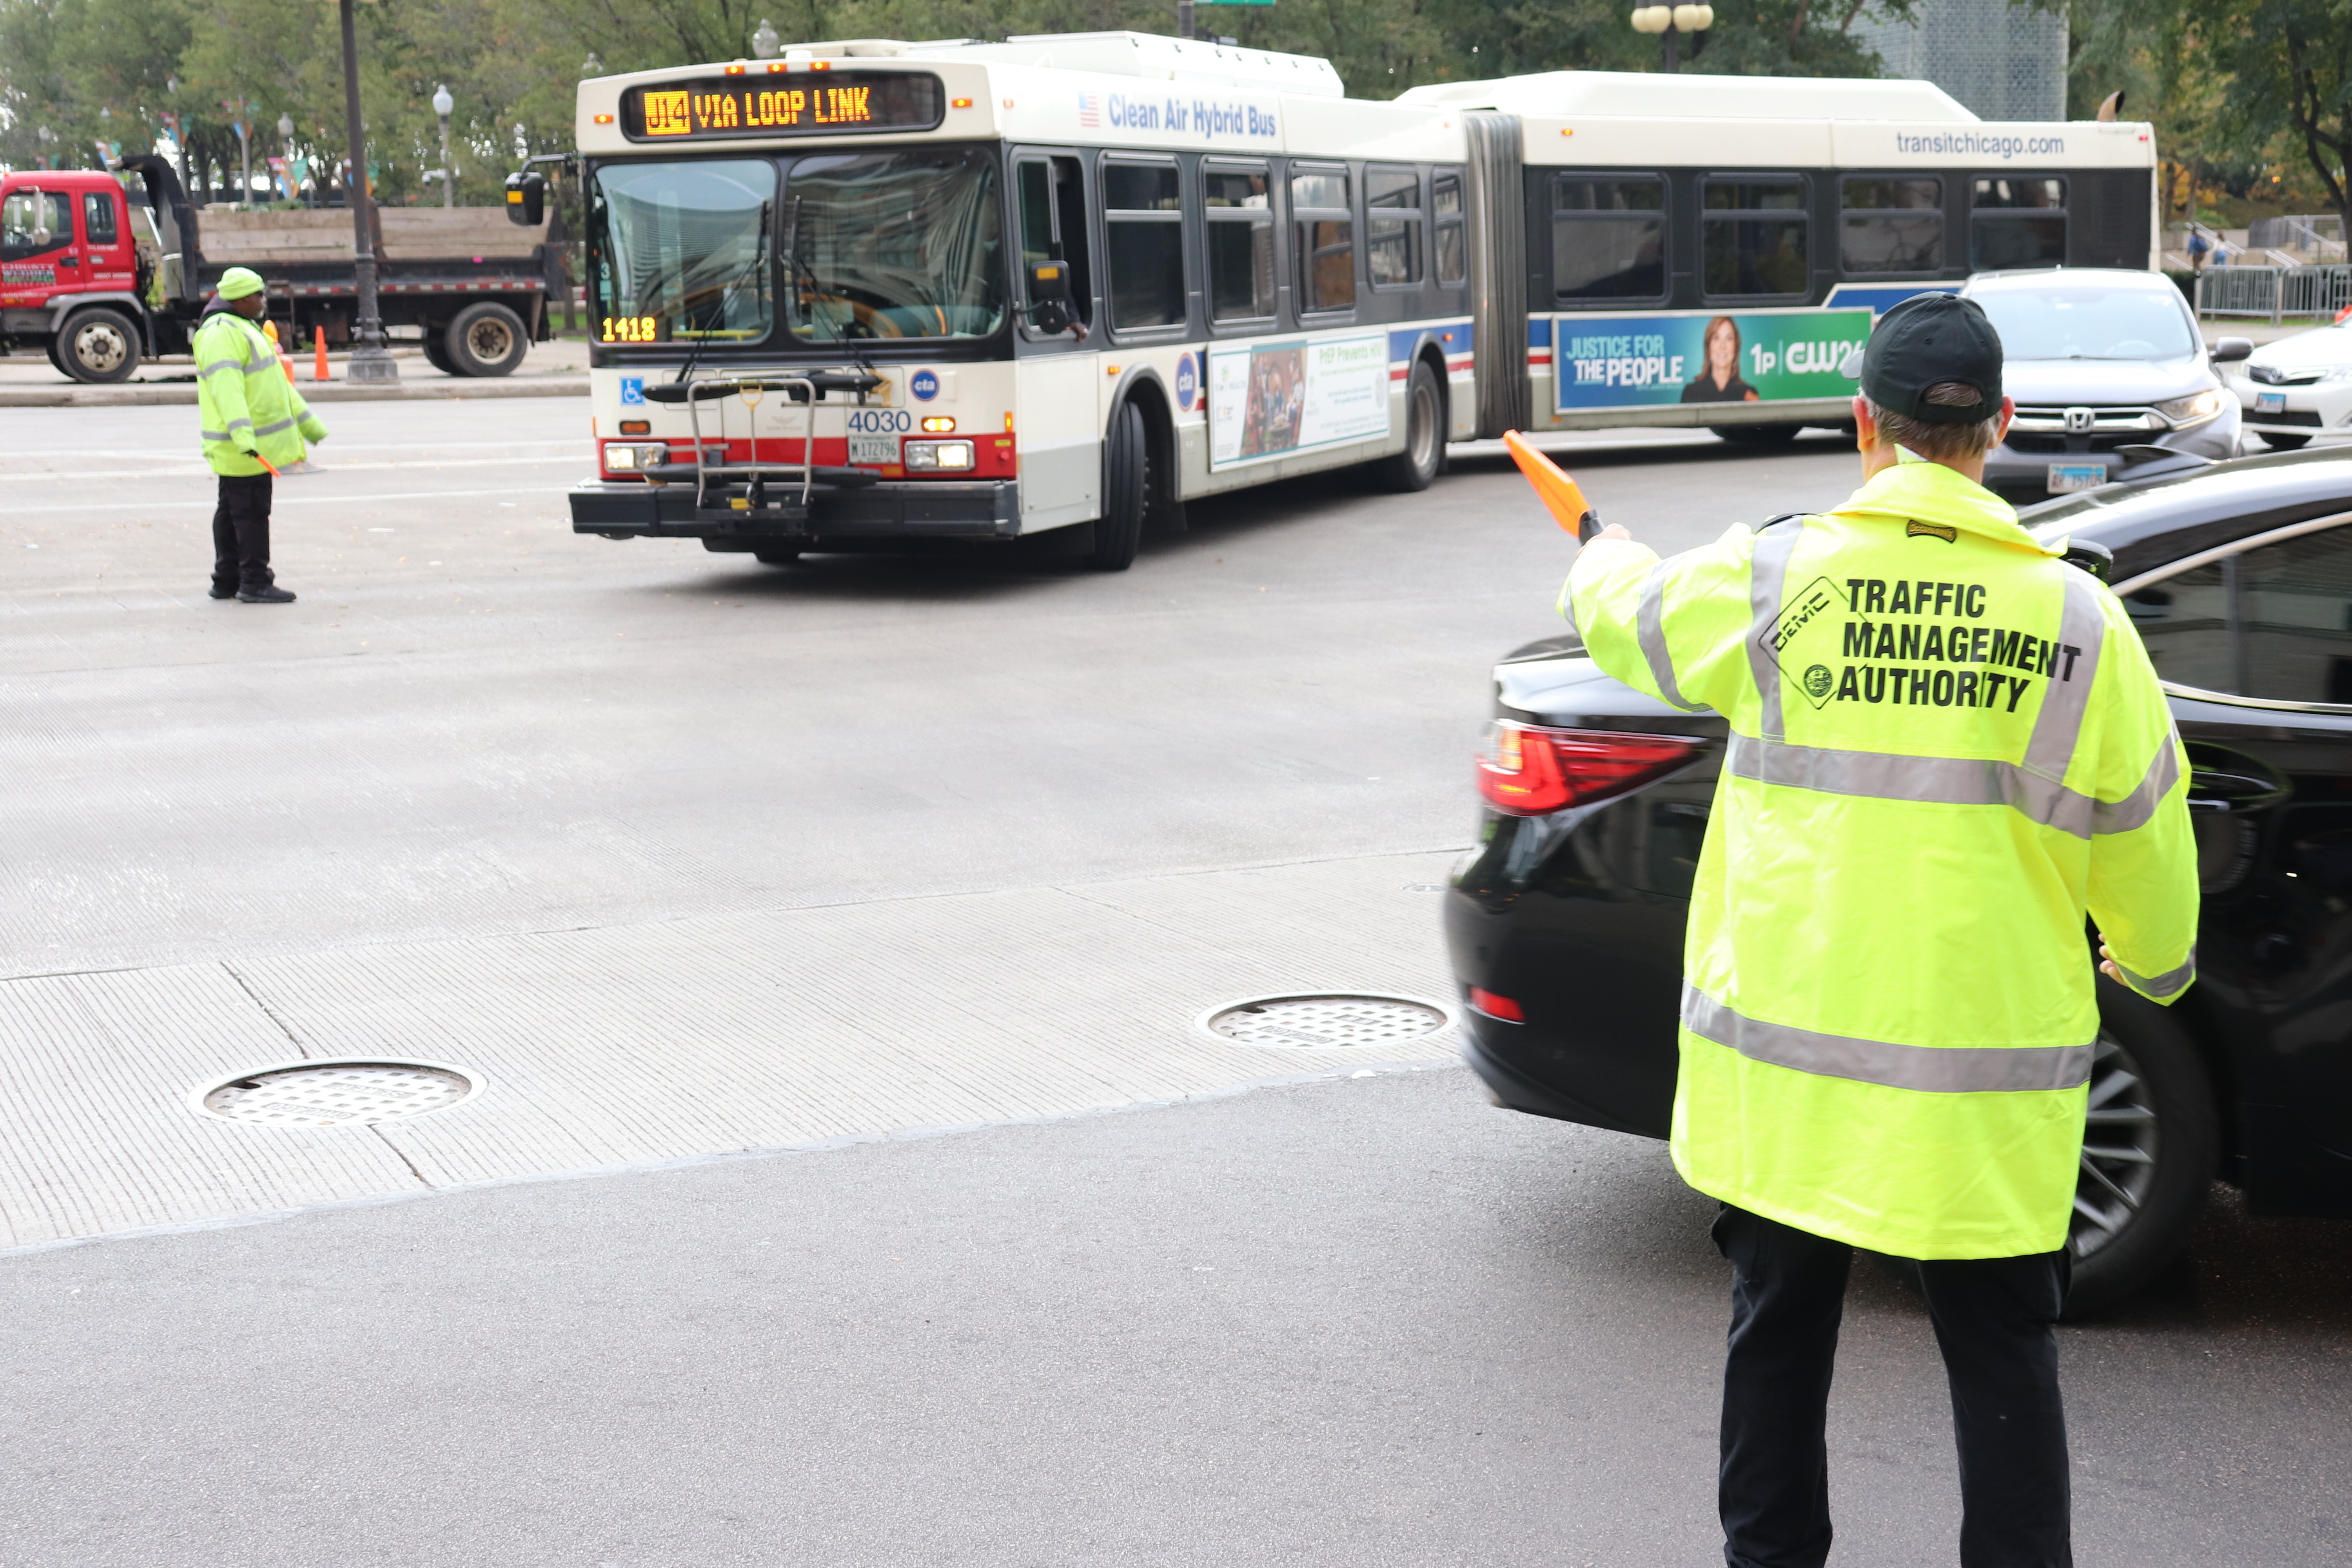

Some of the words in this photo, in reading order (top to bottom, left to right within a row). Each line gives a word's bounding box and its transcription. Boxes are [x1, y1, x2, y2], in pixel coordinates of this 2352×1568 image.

[645, 94, 691, 132] J14
[695, 94, 738, 128] VIA
[745, 91, 806, 125] LOOP
[814, 87, 871, 122] LINK
[1109, 93, 1158, 129] Clean
[1165, 98, 1187, 130] Air
[1193, 100, 1243, 139] Hybrid
[1248, 105, 1276, 136] Bus
[1897, 132, 2064, 159] transitchicago.com
[603, 317, 656, 342] 1418
[1337, 343, 1368, 362] Prevents
[1566, 336, 1632, 360] JUSTICE
[1633, 334, 1665, 357] FOR
[1750, 343, 1777, 375] 1p
[1178, 372, 1194, 392] cta
[1573, 358, 1606, 380] THE
[1606, 355, 1684, 387] PEOPLE
[914, 379, 936, 392] cta
[848, 410, 911, 432] 4030
[861, 442, 897, 457] 172796
[1847, 579, 1986, 618] TRAFFIC
[1843, 622, 2082, 682] MANAGEMENT
[1837, 666, 2031, 713] AUTHORITY
[1261, 1026, 1331, 1044] CHICAGO
[338, 1084, 404, 1097] SEWER
[266, 1103, 351, 1120] CHICAGO
